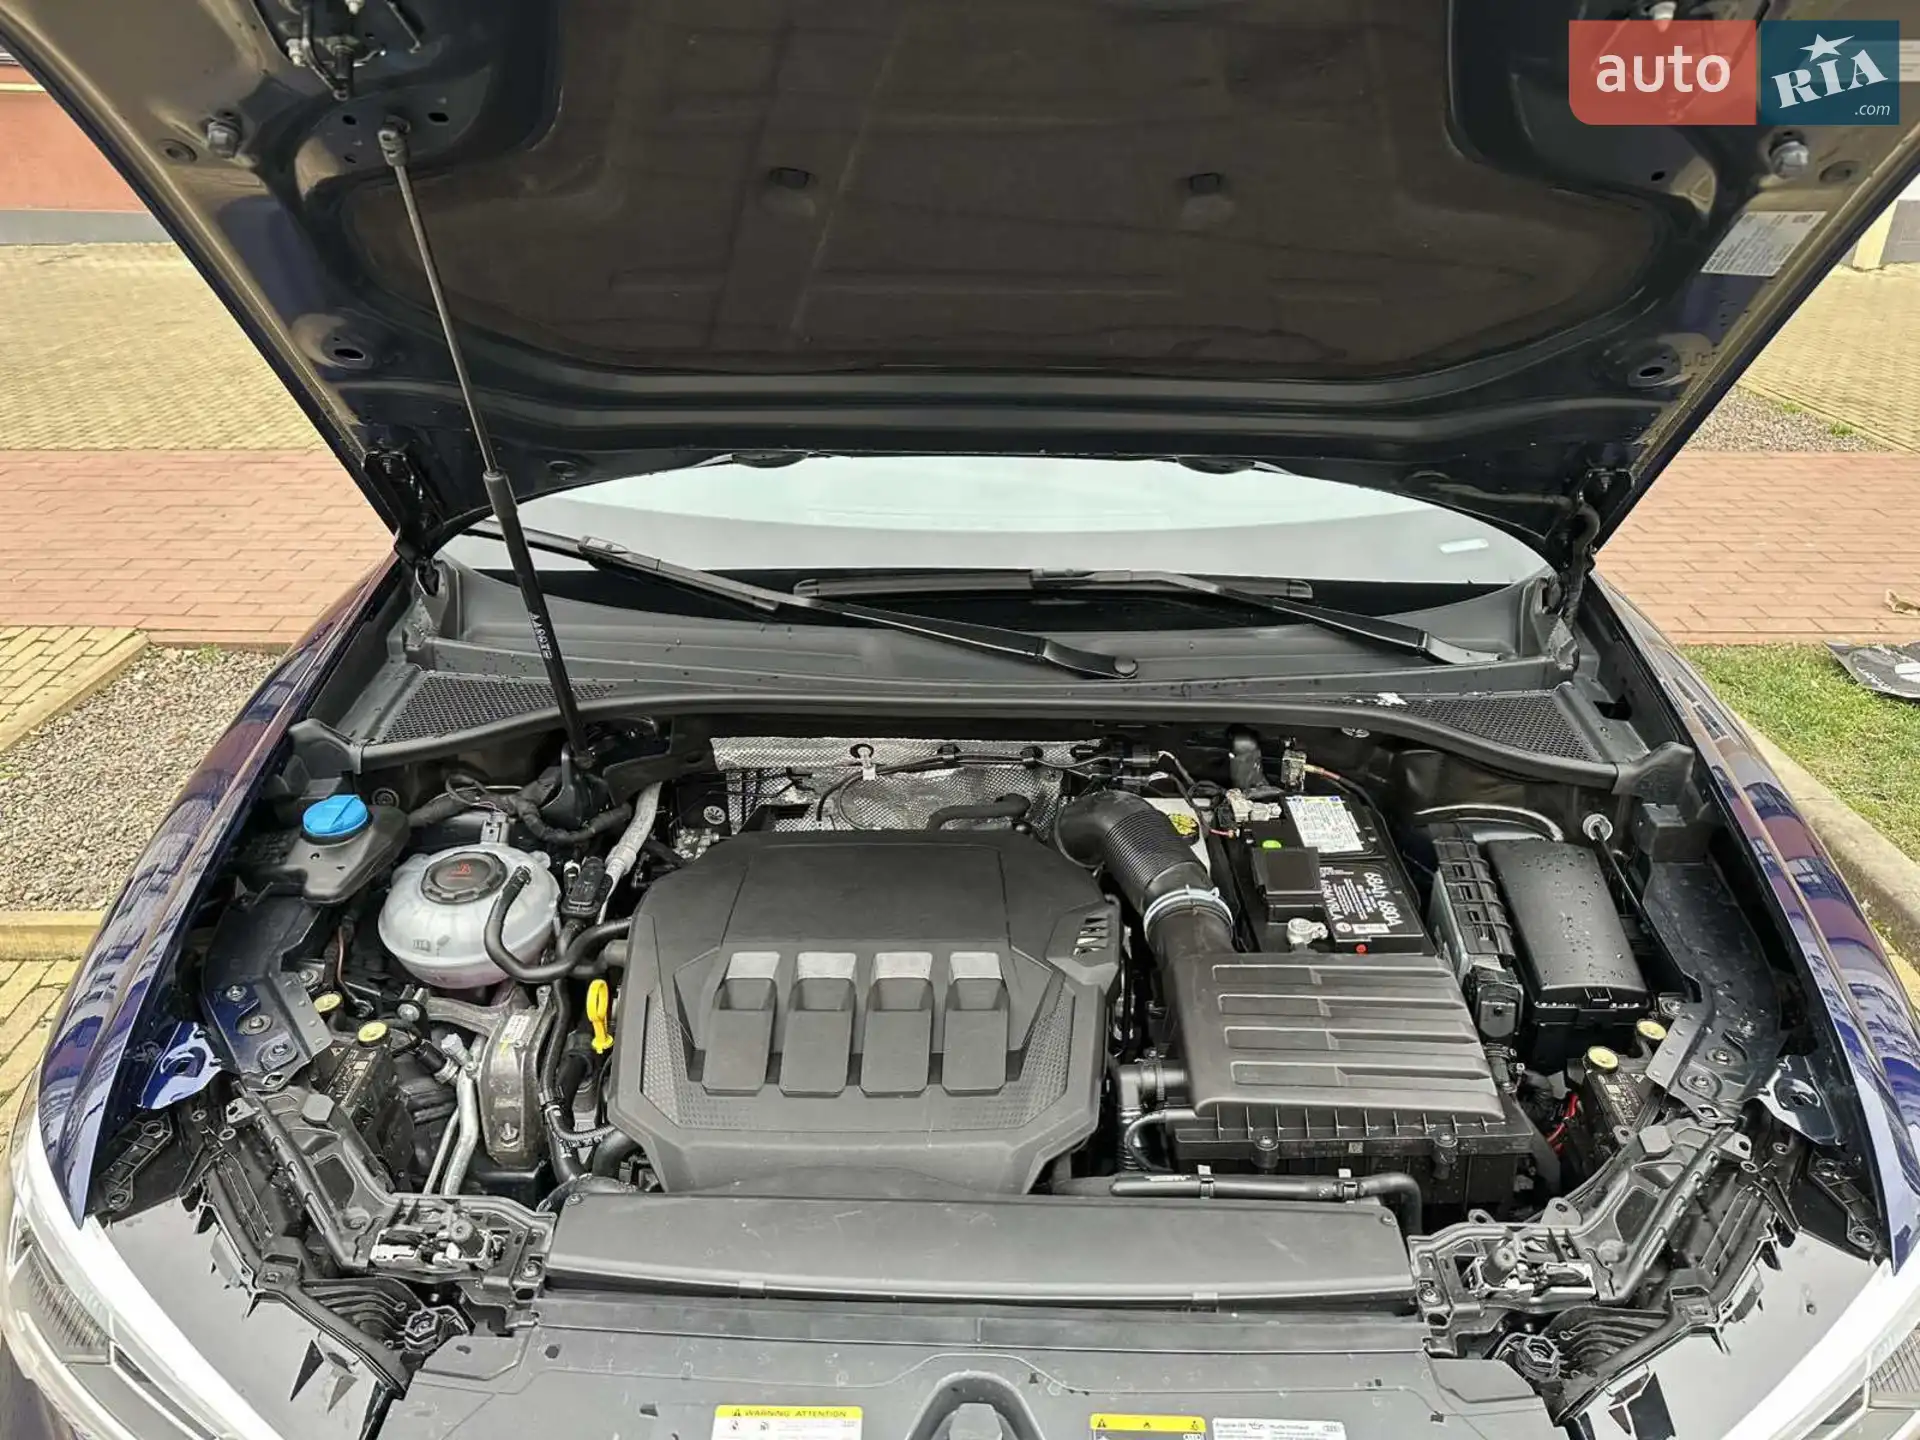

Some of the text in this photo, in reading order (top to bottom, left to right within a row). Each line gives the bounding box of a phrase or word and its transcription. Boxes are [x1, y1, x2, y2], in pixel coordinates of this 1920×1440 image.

[1363, 872, 1390, 898] 68Ah
[745, 1409, 847, 1418] WARNING ATTENTION
